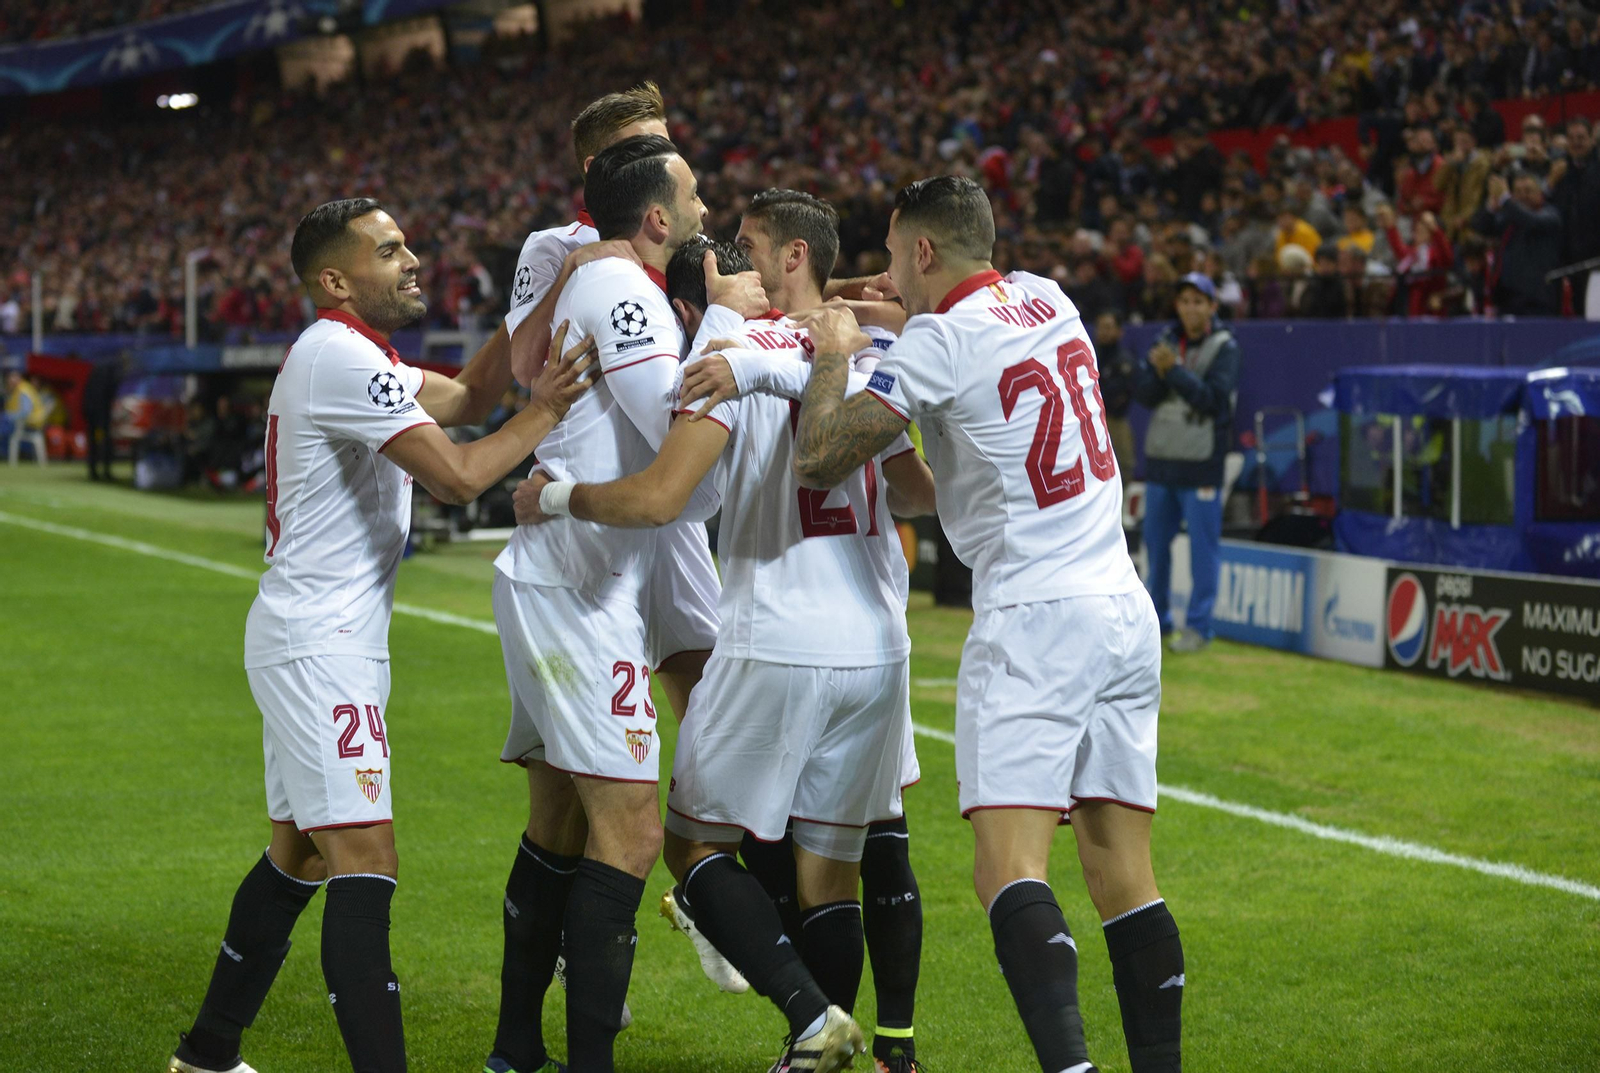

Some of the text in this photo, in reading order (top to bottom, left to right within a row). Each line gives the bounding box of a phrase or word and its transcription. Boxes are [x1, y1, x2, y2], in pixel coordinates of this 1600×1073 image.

[870, 373, 893, 390] SPECT
[997, 338, 1116, 510] 20
[1214, 562, 1305, 632] AZPROM
[1436, 575, 1473, 599] pepsi
[1427, 602, 1511, 681] MAX
[1522, 645, 1552, 676] NO
[333, 703, 389, 759] 24
